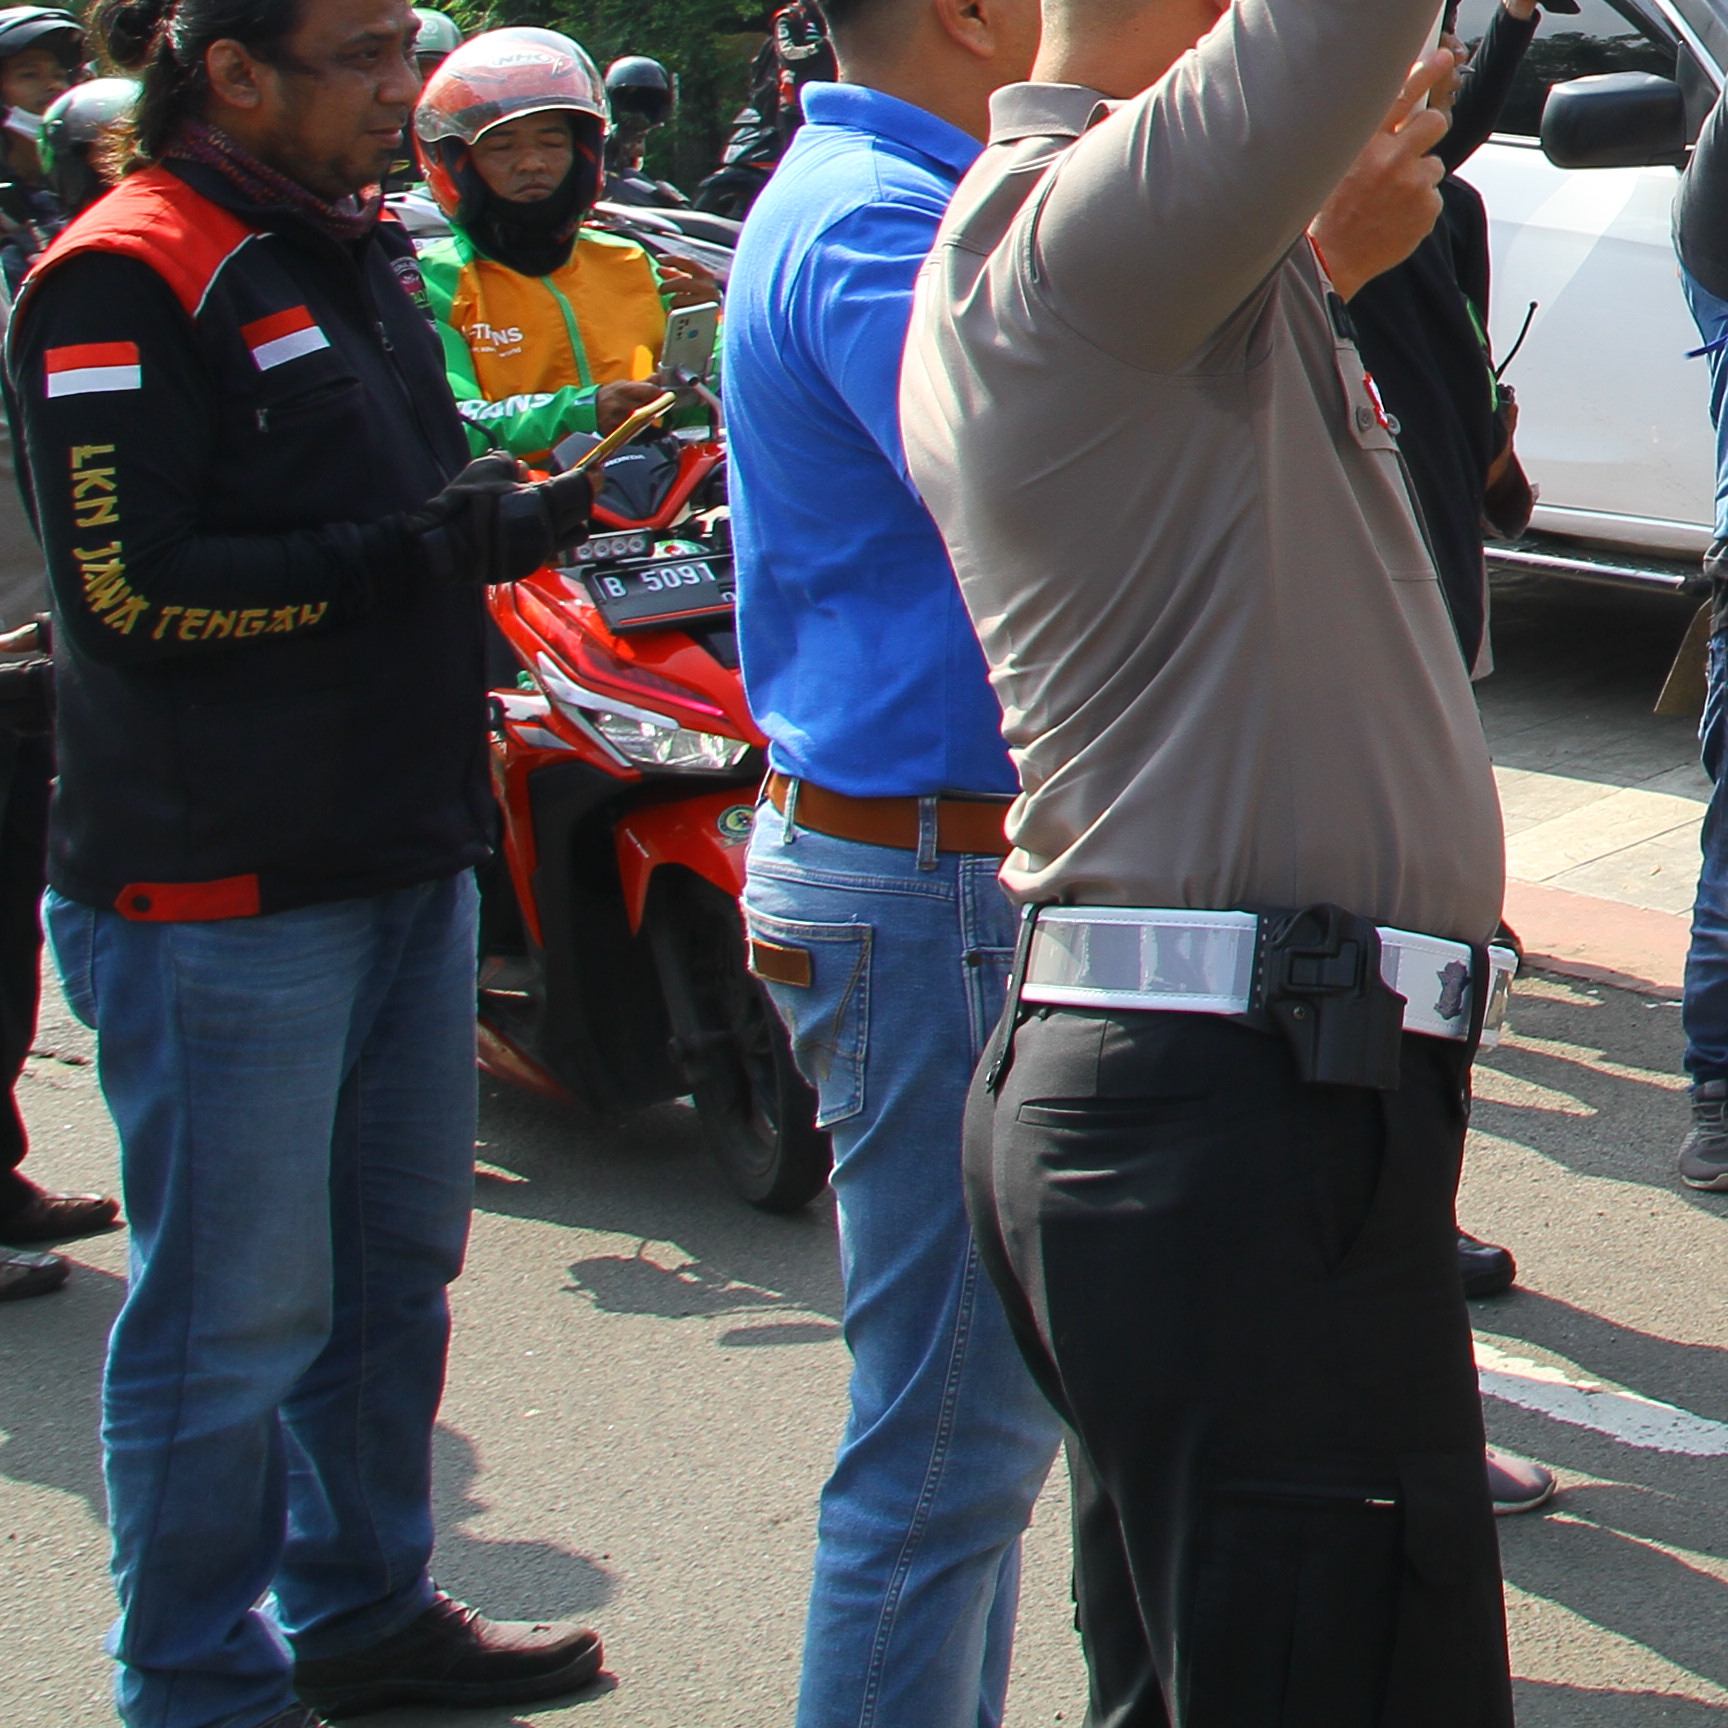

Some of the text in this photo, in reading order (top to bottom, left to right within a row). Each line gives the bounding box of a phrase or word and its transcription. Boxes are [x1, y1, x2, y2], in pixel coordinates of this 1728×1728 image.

[603, 562, 716, 598] B 5091
[151, 601, 329, 641] TENGAH
